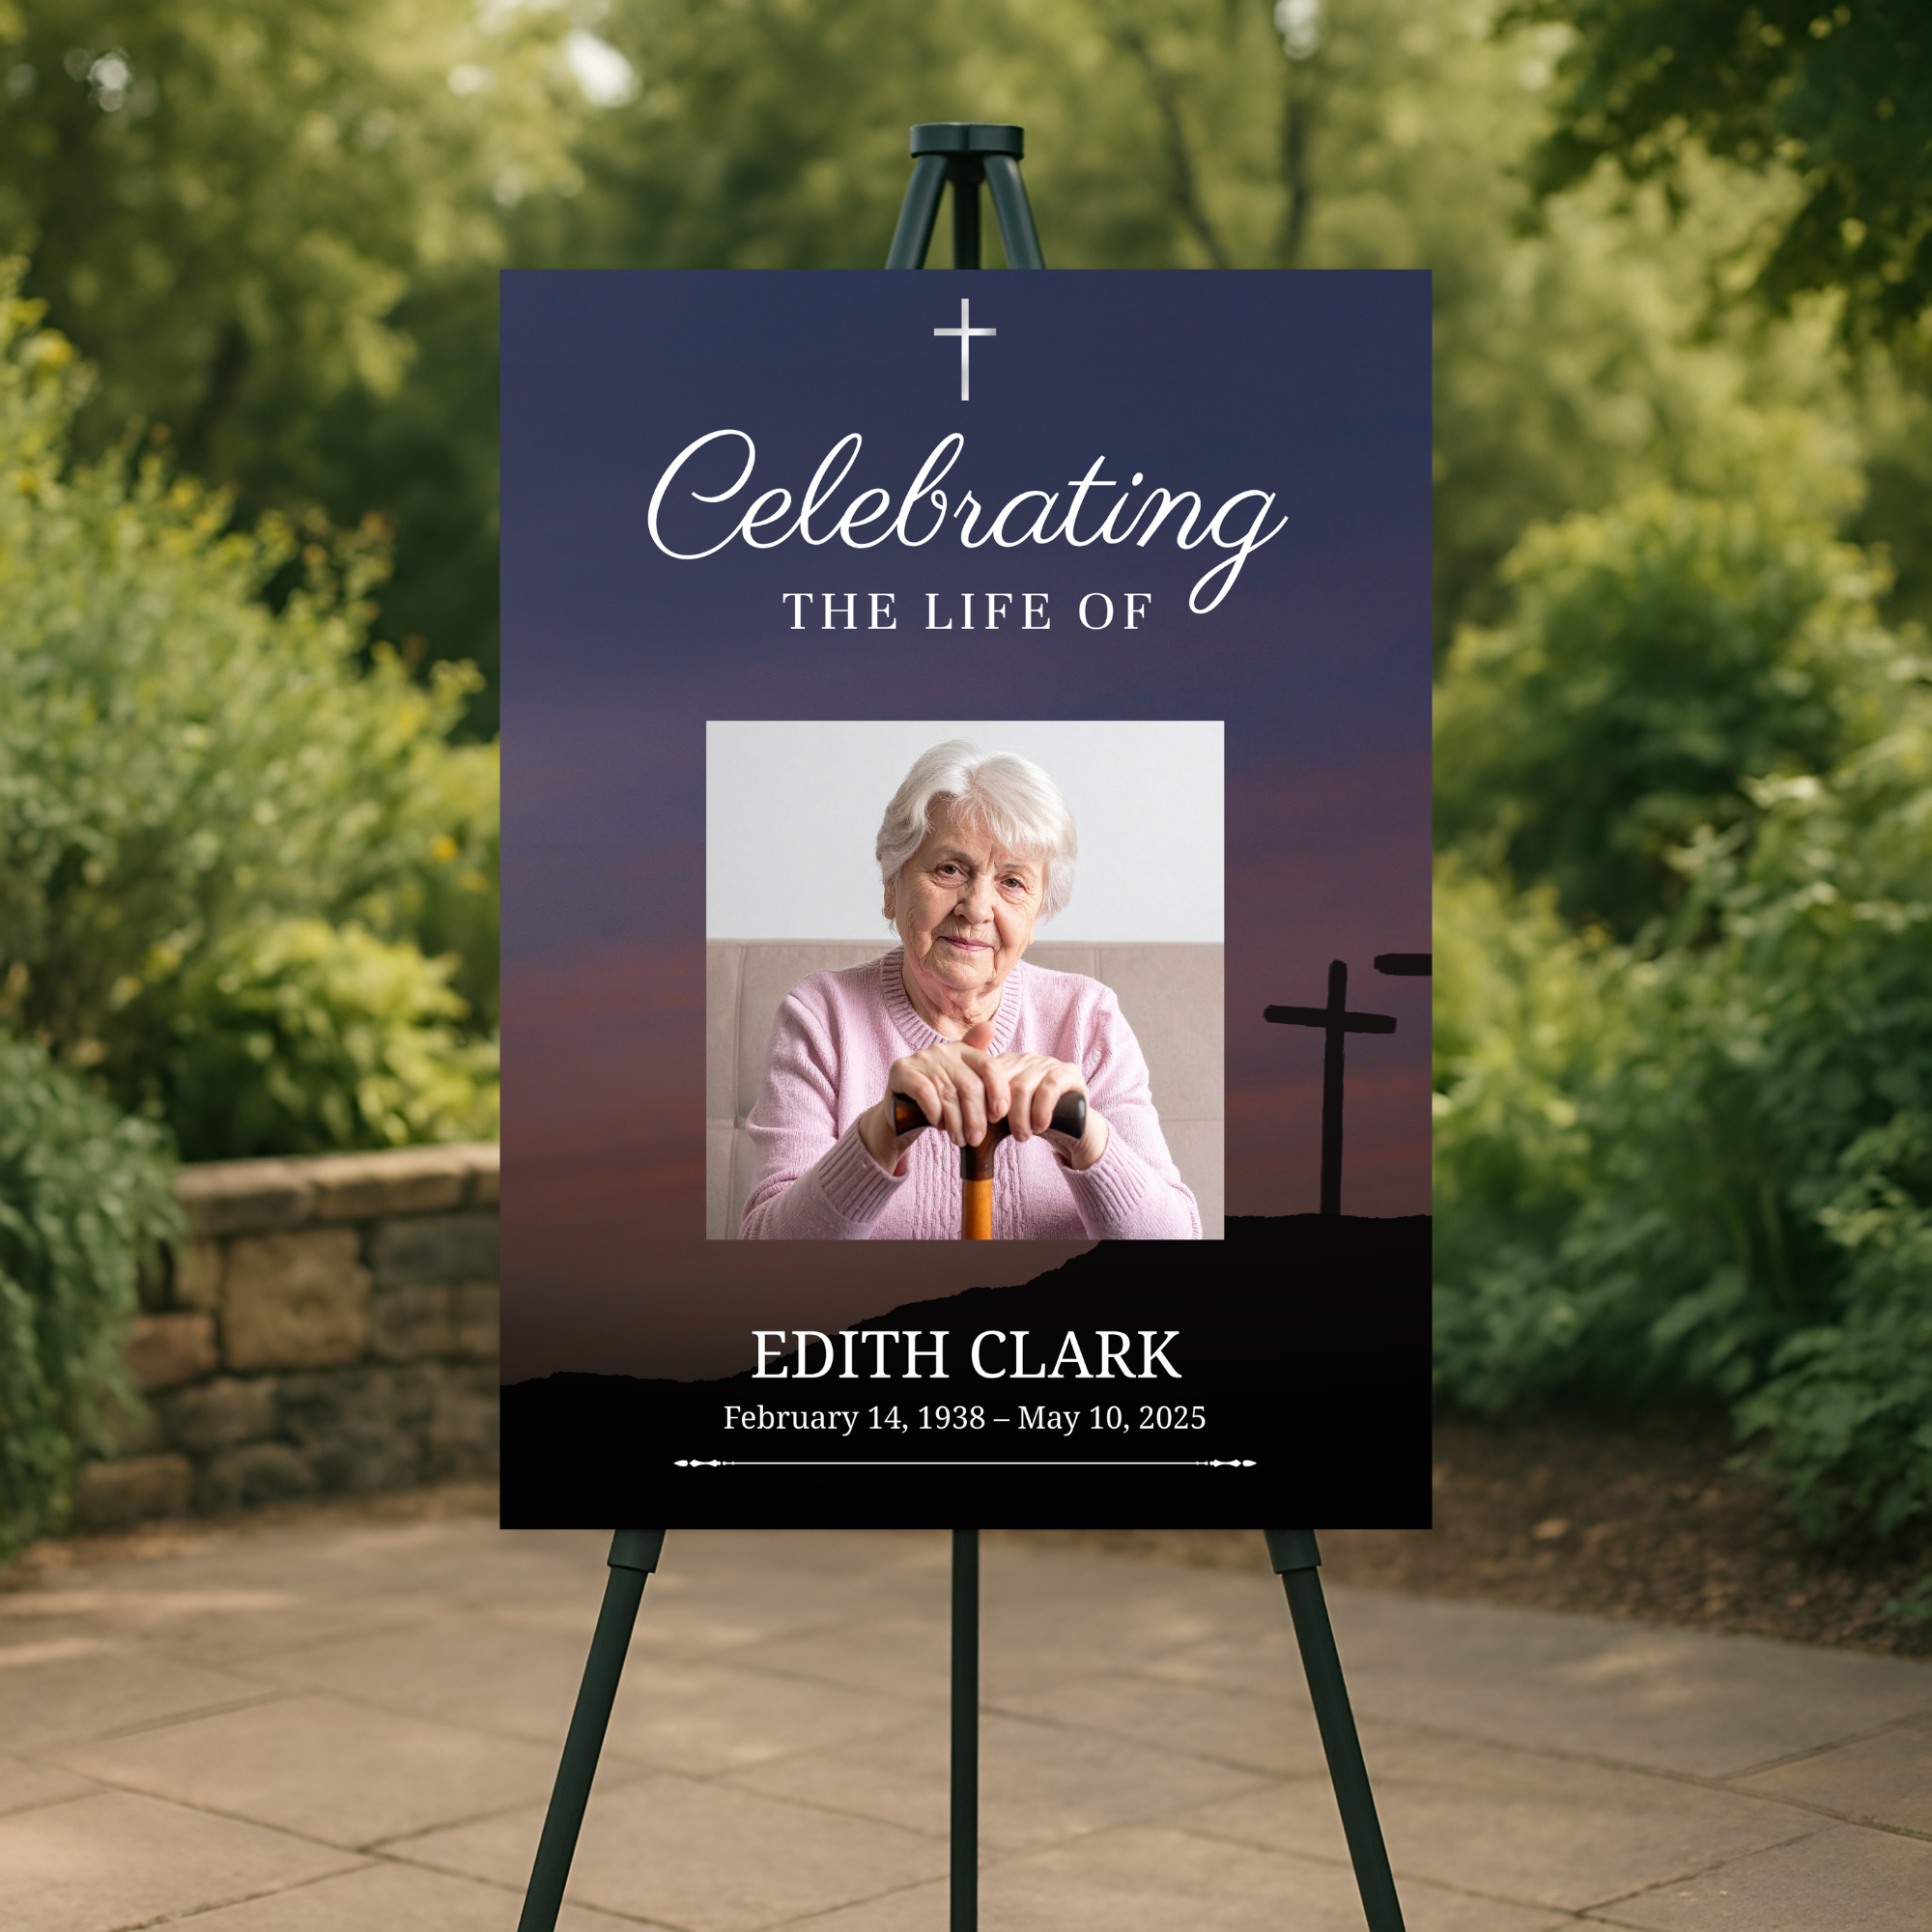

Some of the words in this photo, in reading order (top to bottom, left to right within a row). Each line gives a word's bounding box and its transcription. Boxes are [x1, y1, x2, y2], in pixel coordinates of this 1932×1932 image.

[647, 428, 1289, 614] Celebrating
[782, 592, 896, 630] THE
[924, 592, 1051, 630] LIFE
[1078, 592, 1151, 631] OF
[752, 1330, 950, 1378] EDITH
[971, 1329, 1182, 1379] CLARK
[724, 1404, 860, 1436] February
[868, 1406, 908, 1434] 14,
[919, 1405, 985, 1430] 1938
[1017, 1406, 1081, 1436] May
[1090, 1405, 1129, 1434] 10,
[1139, 1405, 1206, 1430] 2025
